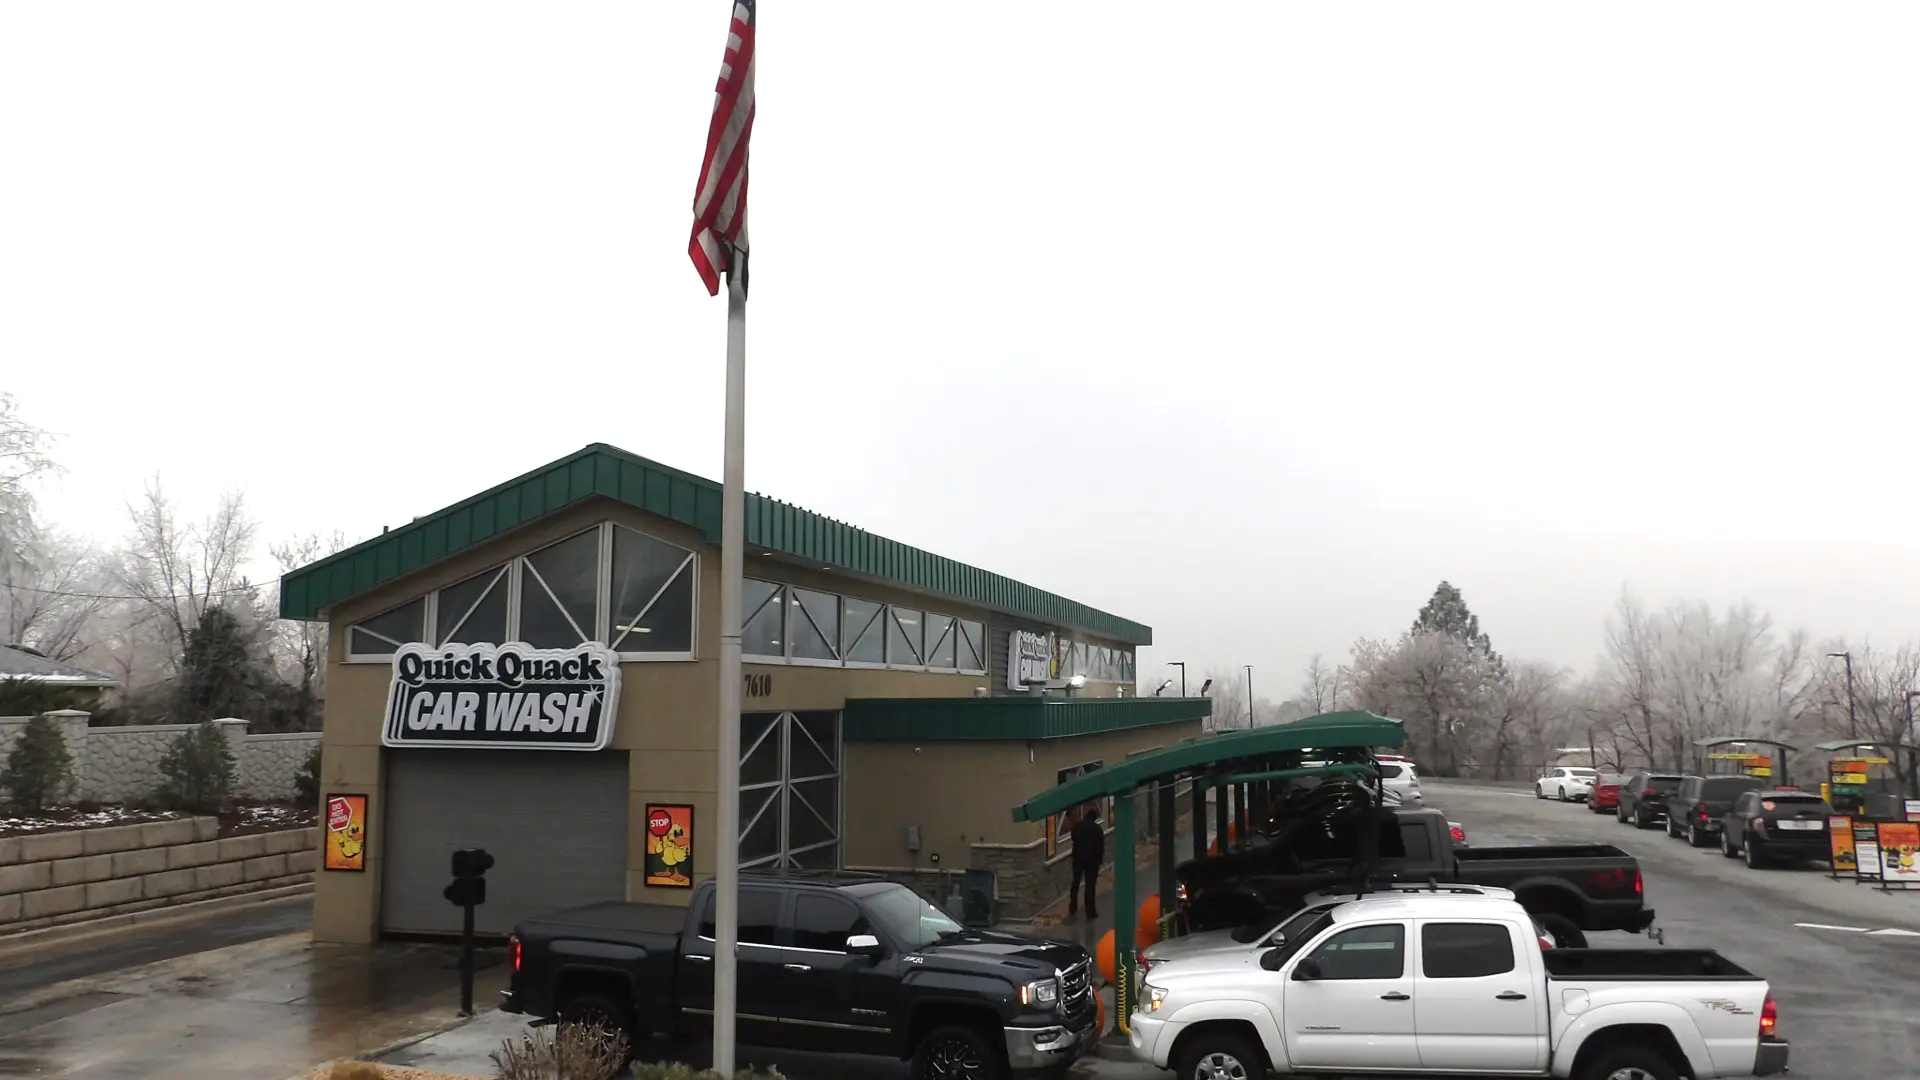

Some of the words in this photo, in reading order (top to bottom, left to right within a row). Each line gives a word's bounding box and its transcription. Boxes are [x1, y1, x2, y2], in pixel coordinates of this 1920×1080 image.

[399, 652, 494, 687] Quick
[496, 653, 604, 687] Quack
[744, 674, 772, 696] 7610
[408, 692, 480, 731] CAR
[486, 692, 593, 733] WASH
[650, 818, 670, 828] STOP
